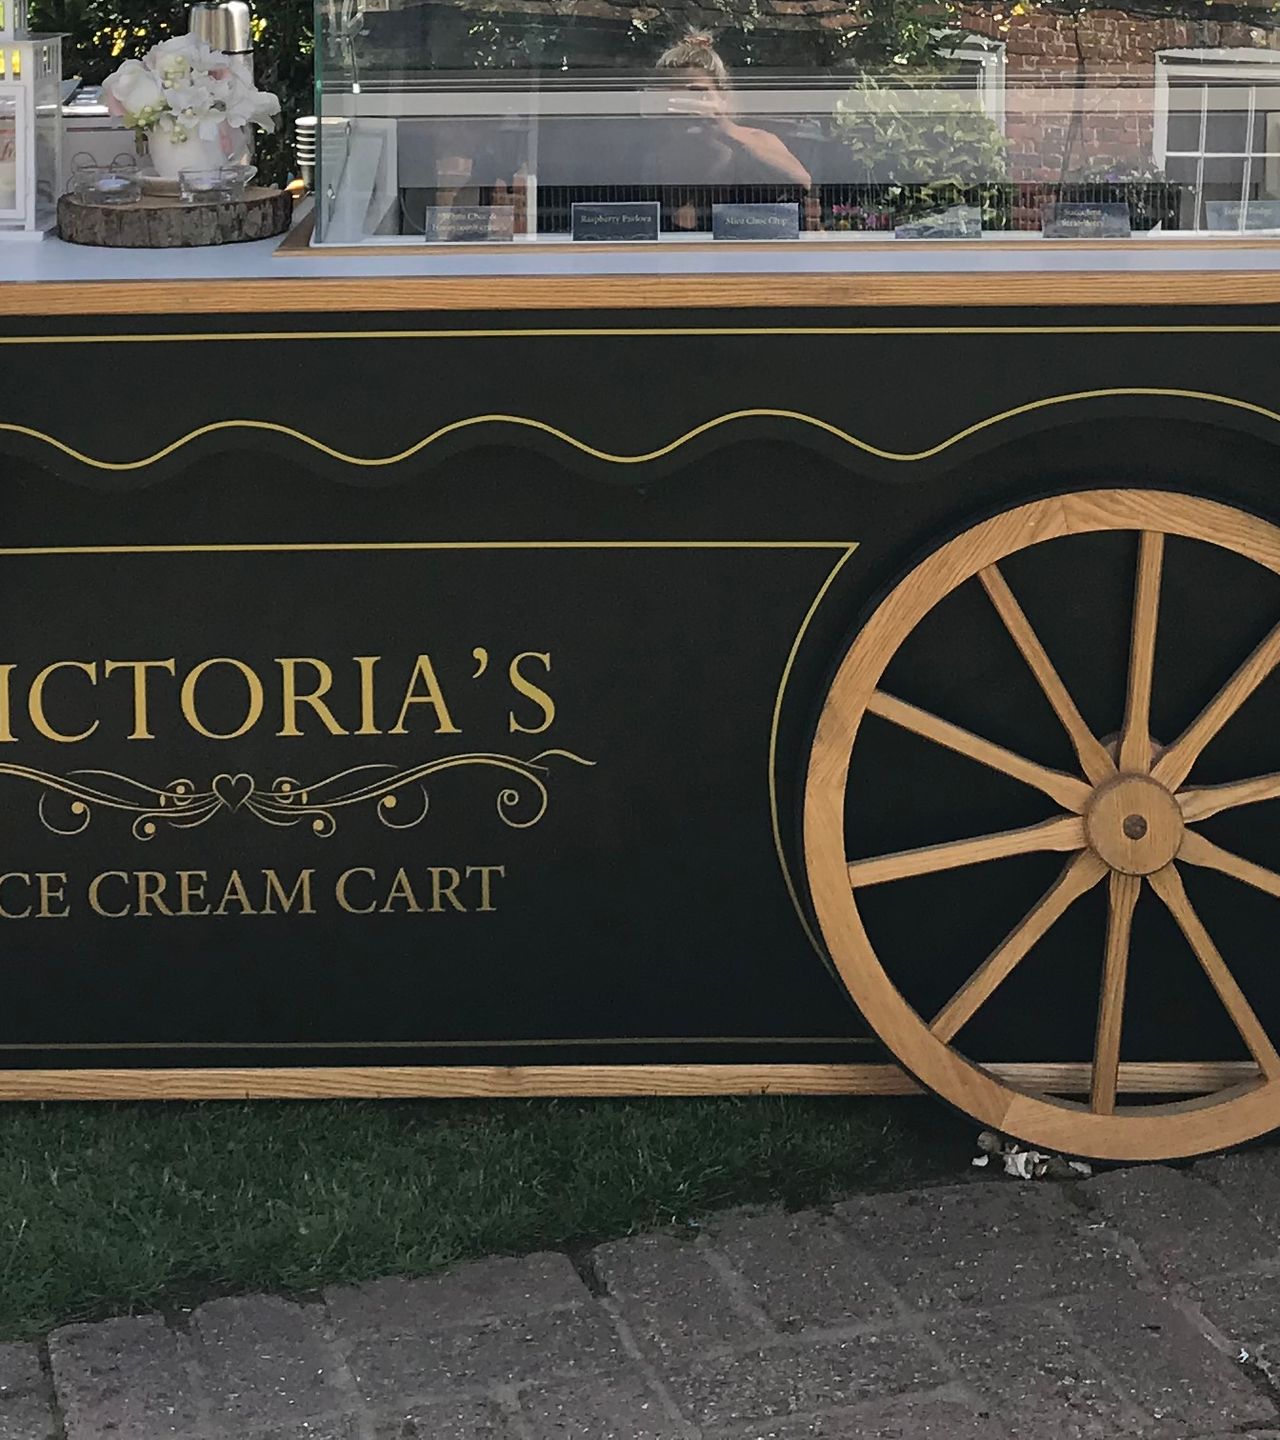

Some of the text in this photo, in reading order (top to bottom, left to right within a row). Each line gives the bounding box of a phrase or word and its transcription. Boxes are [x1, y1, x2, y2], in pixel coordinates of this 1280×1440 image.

[581, 214, 652, 225] Raspberry Pavlova
[88, 870, 317, 917] CREAM
[336, 866, 506, 913] CART
